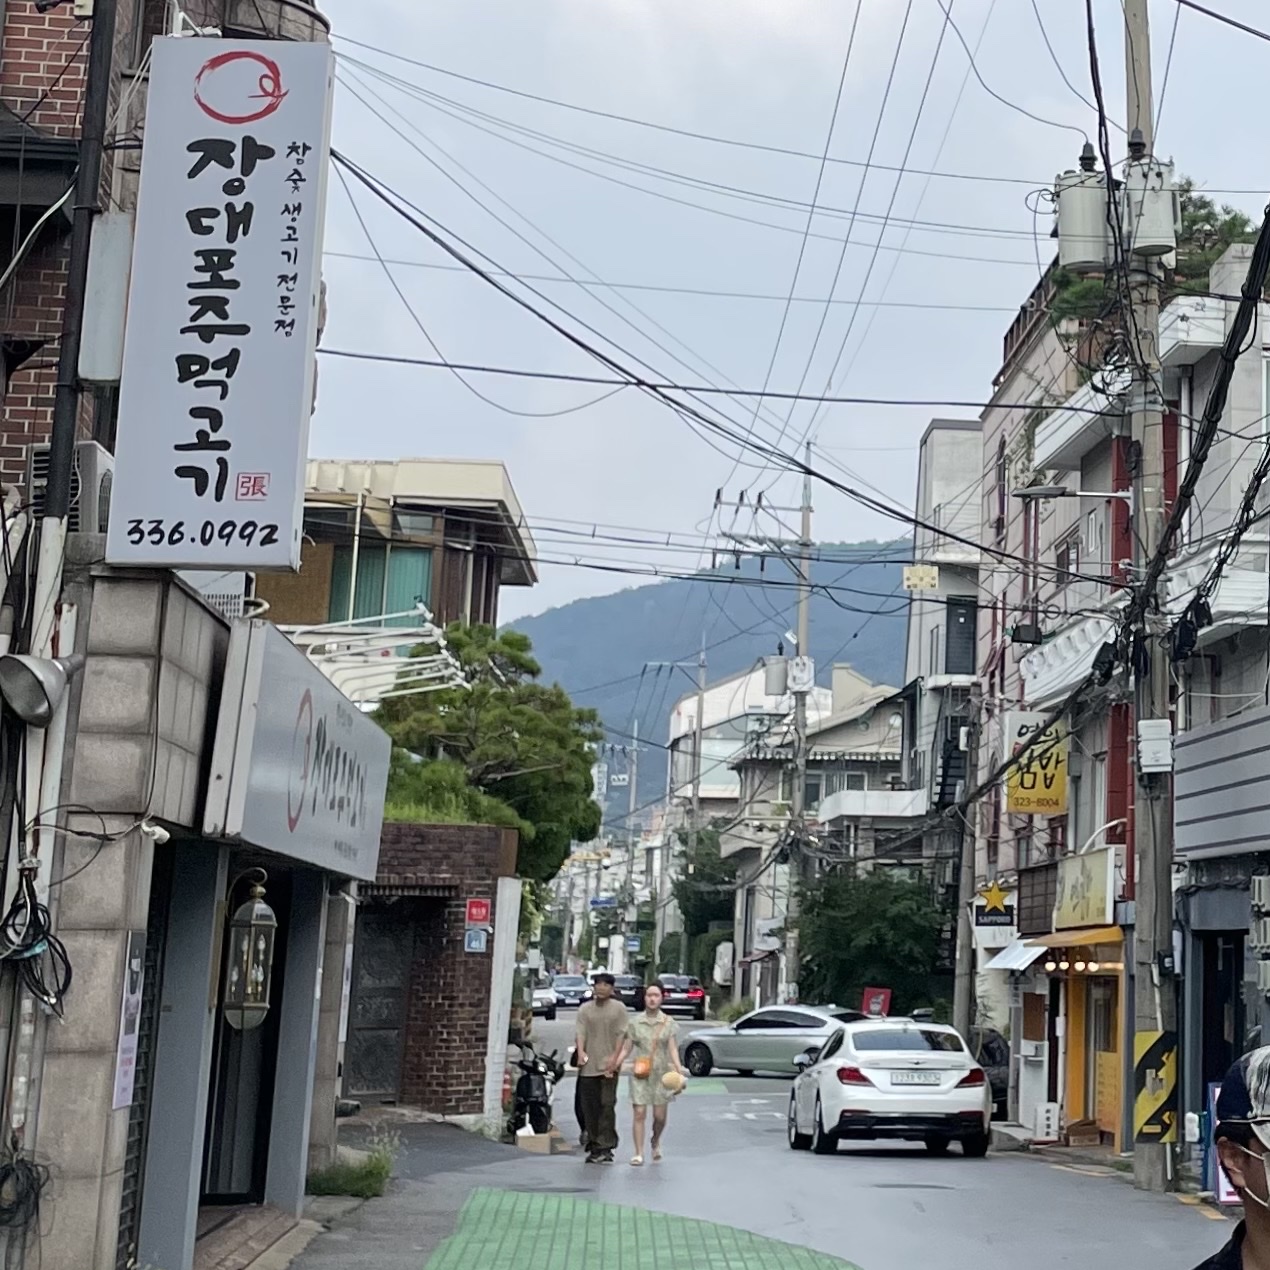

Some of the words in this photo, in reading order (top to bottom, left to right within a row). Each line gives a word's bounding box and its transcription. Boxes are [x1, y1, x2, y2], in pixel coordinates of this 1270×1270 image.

[274, 202, 302, 338] 생고기전문점
[173, 135, 276, 503] 장대포주먹고기
[239, 475, 268, 497] 張
[127, 518, 280, 547] 336.0992
